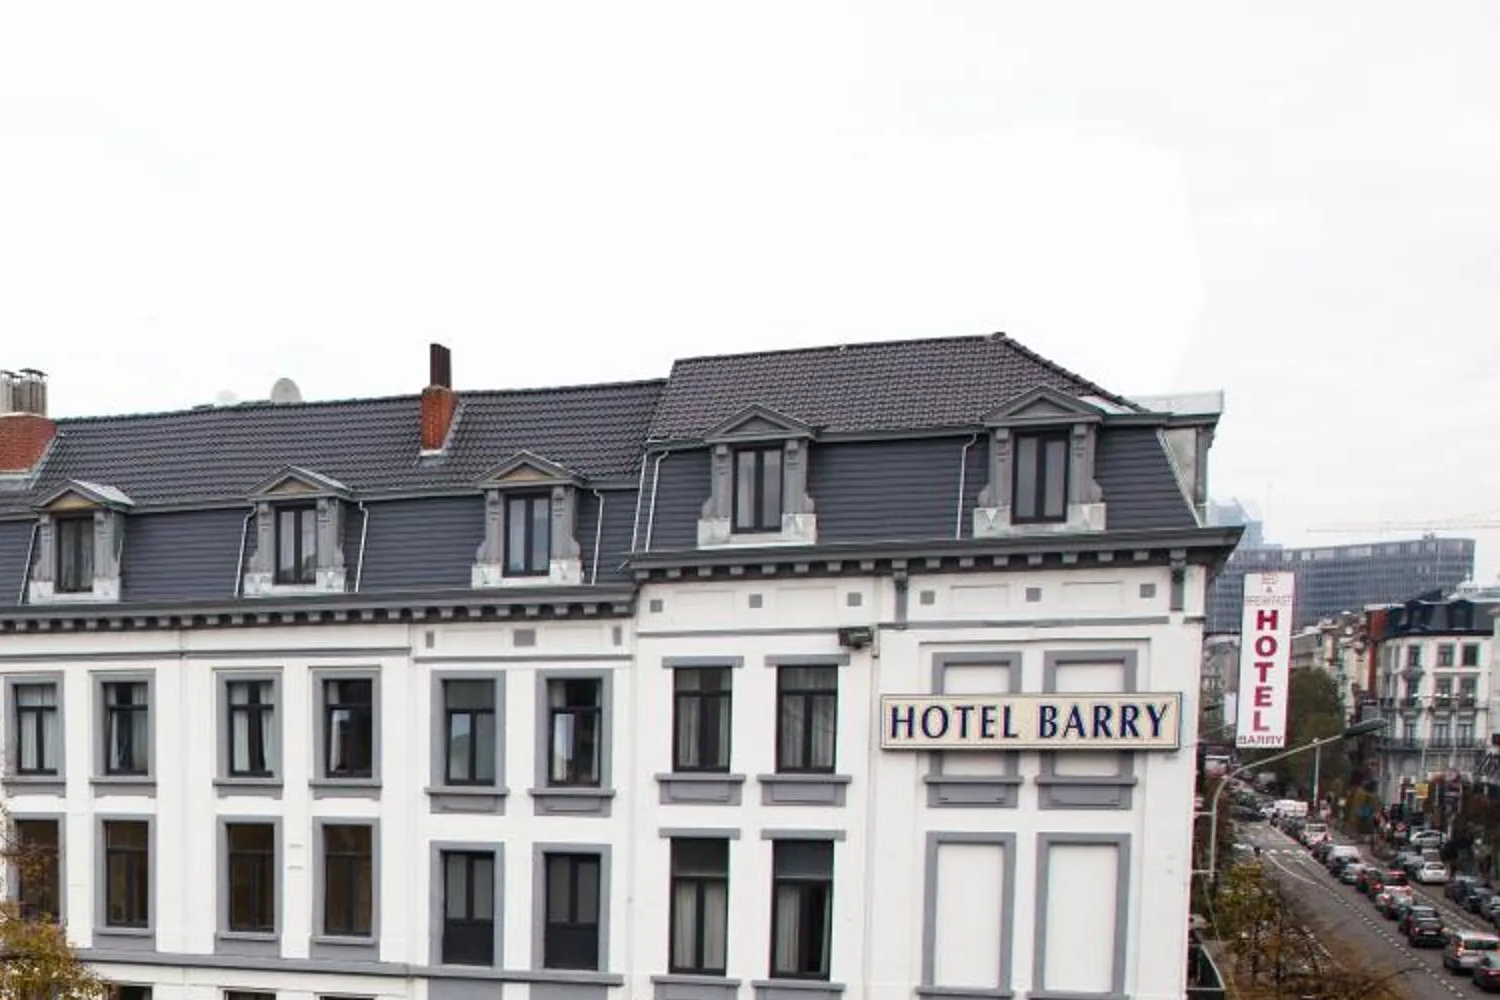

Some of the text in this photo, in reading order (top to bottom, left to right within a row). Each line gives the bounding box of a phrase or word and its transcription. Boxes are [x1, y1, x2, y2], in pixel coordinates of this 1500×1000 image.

[1253, 609, 1278, 732] HOTEL
[890, 703, 1169, 739] HOTEL BARRY
[1237, 735, 1283, 745] BARRY
